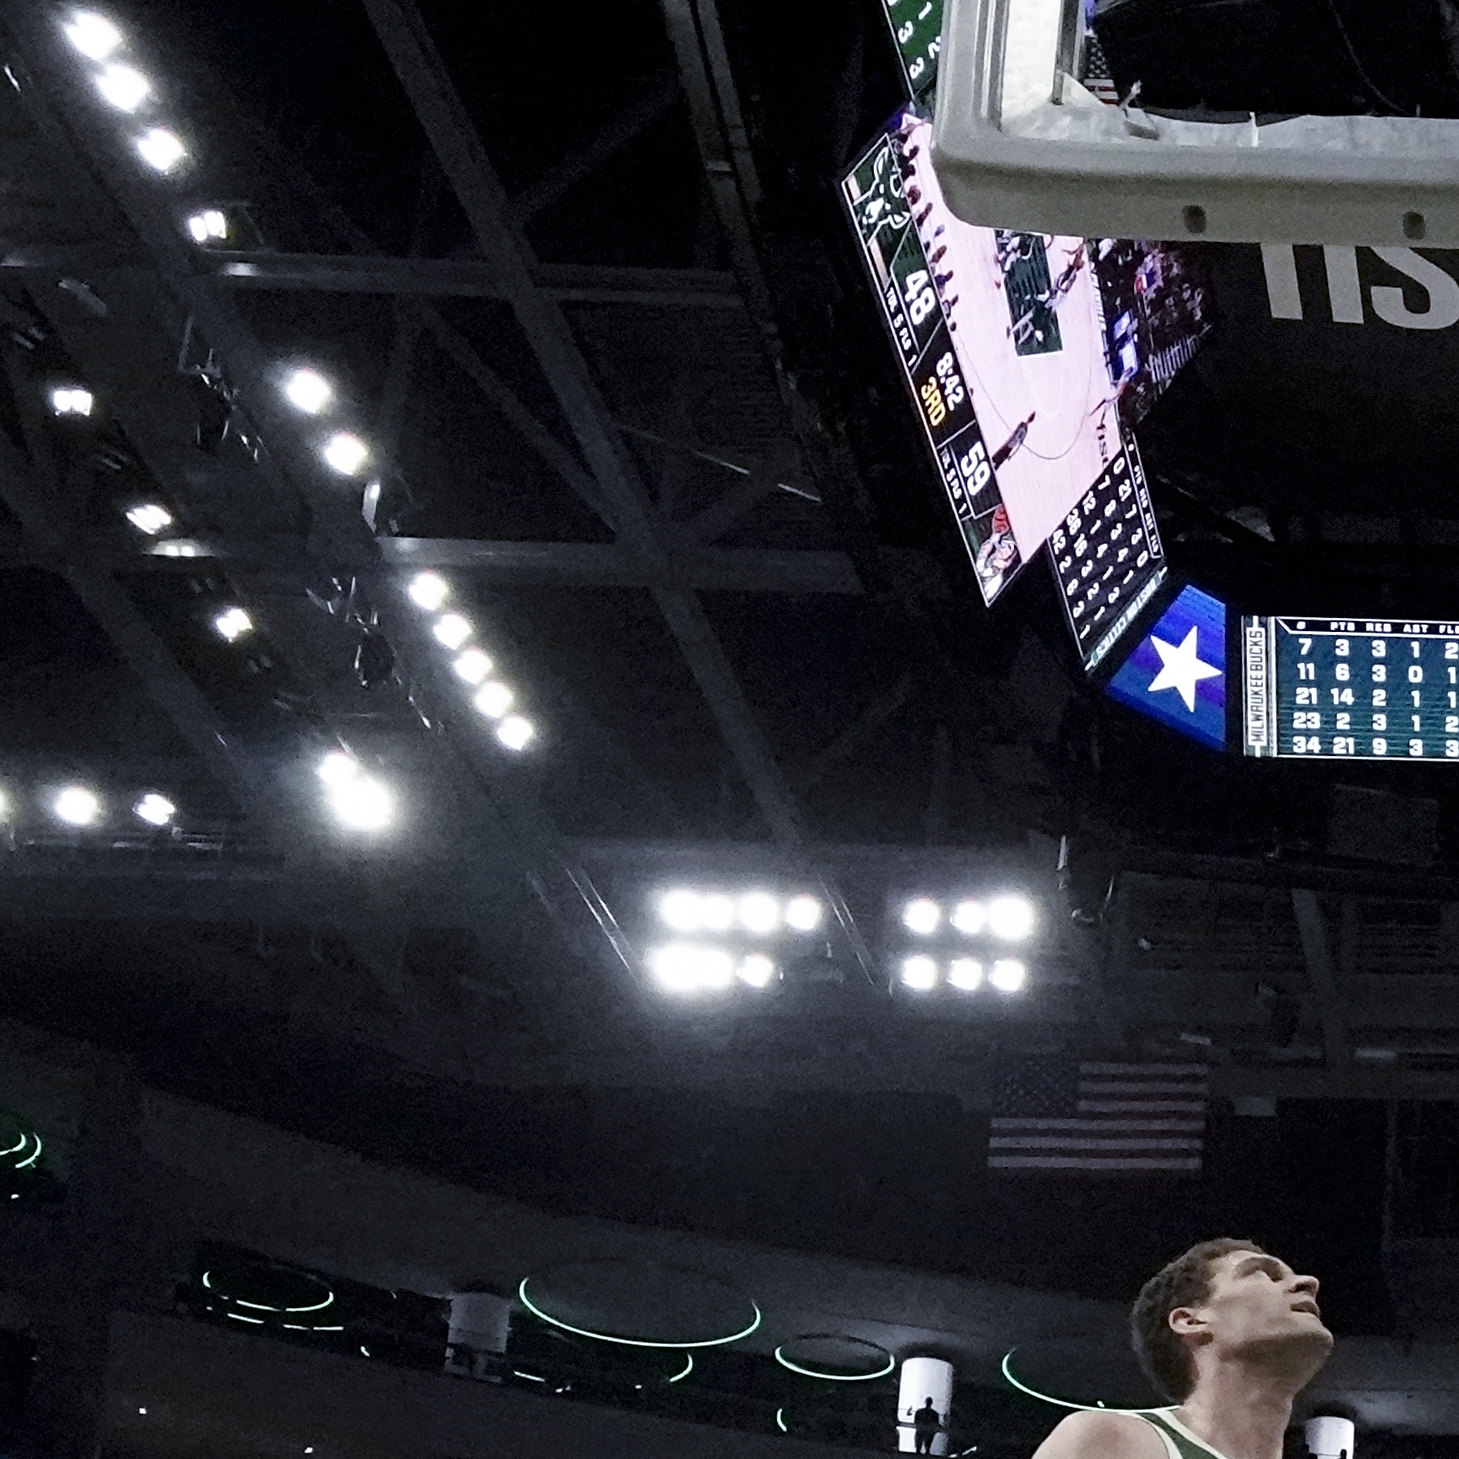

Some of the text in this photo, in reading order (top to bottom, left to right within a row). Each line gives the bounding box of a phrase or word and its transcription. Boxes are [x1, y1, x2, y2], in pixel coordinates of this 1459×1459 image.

[904, 269, 936, 325] 48
[921, 376, 945, 426] 3RD
[936, 352, 965, 411] 8:42
[961, 440, 990, 496] 59
[1250, 630, 1265, 743] MILWAUKEE BUCKS
[1292, 736, 1459, 757] 34 21 9 3 3
